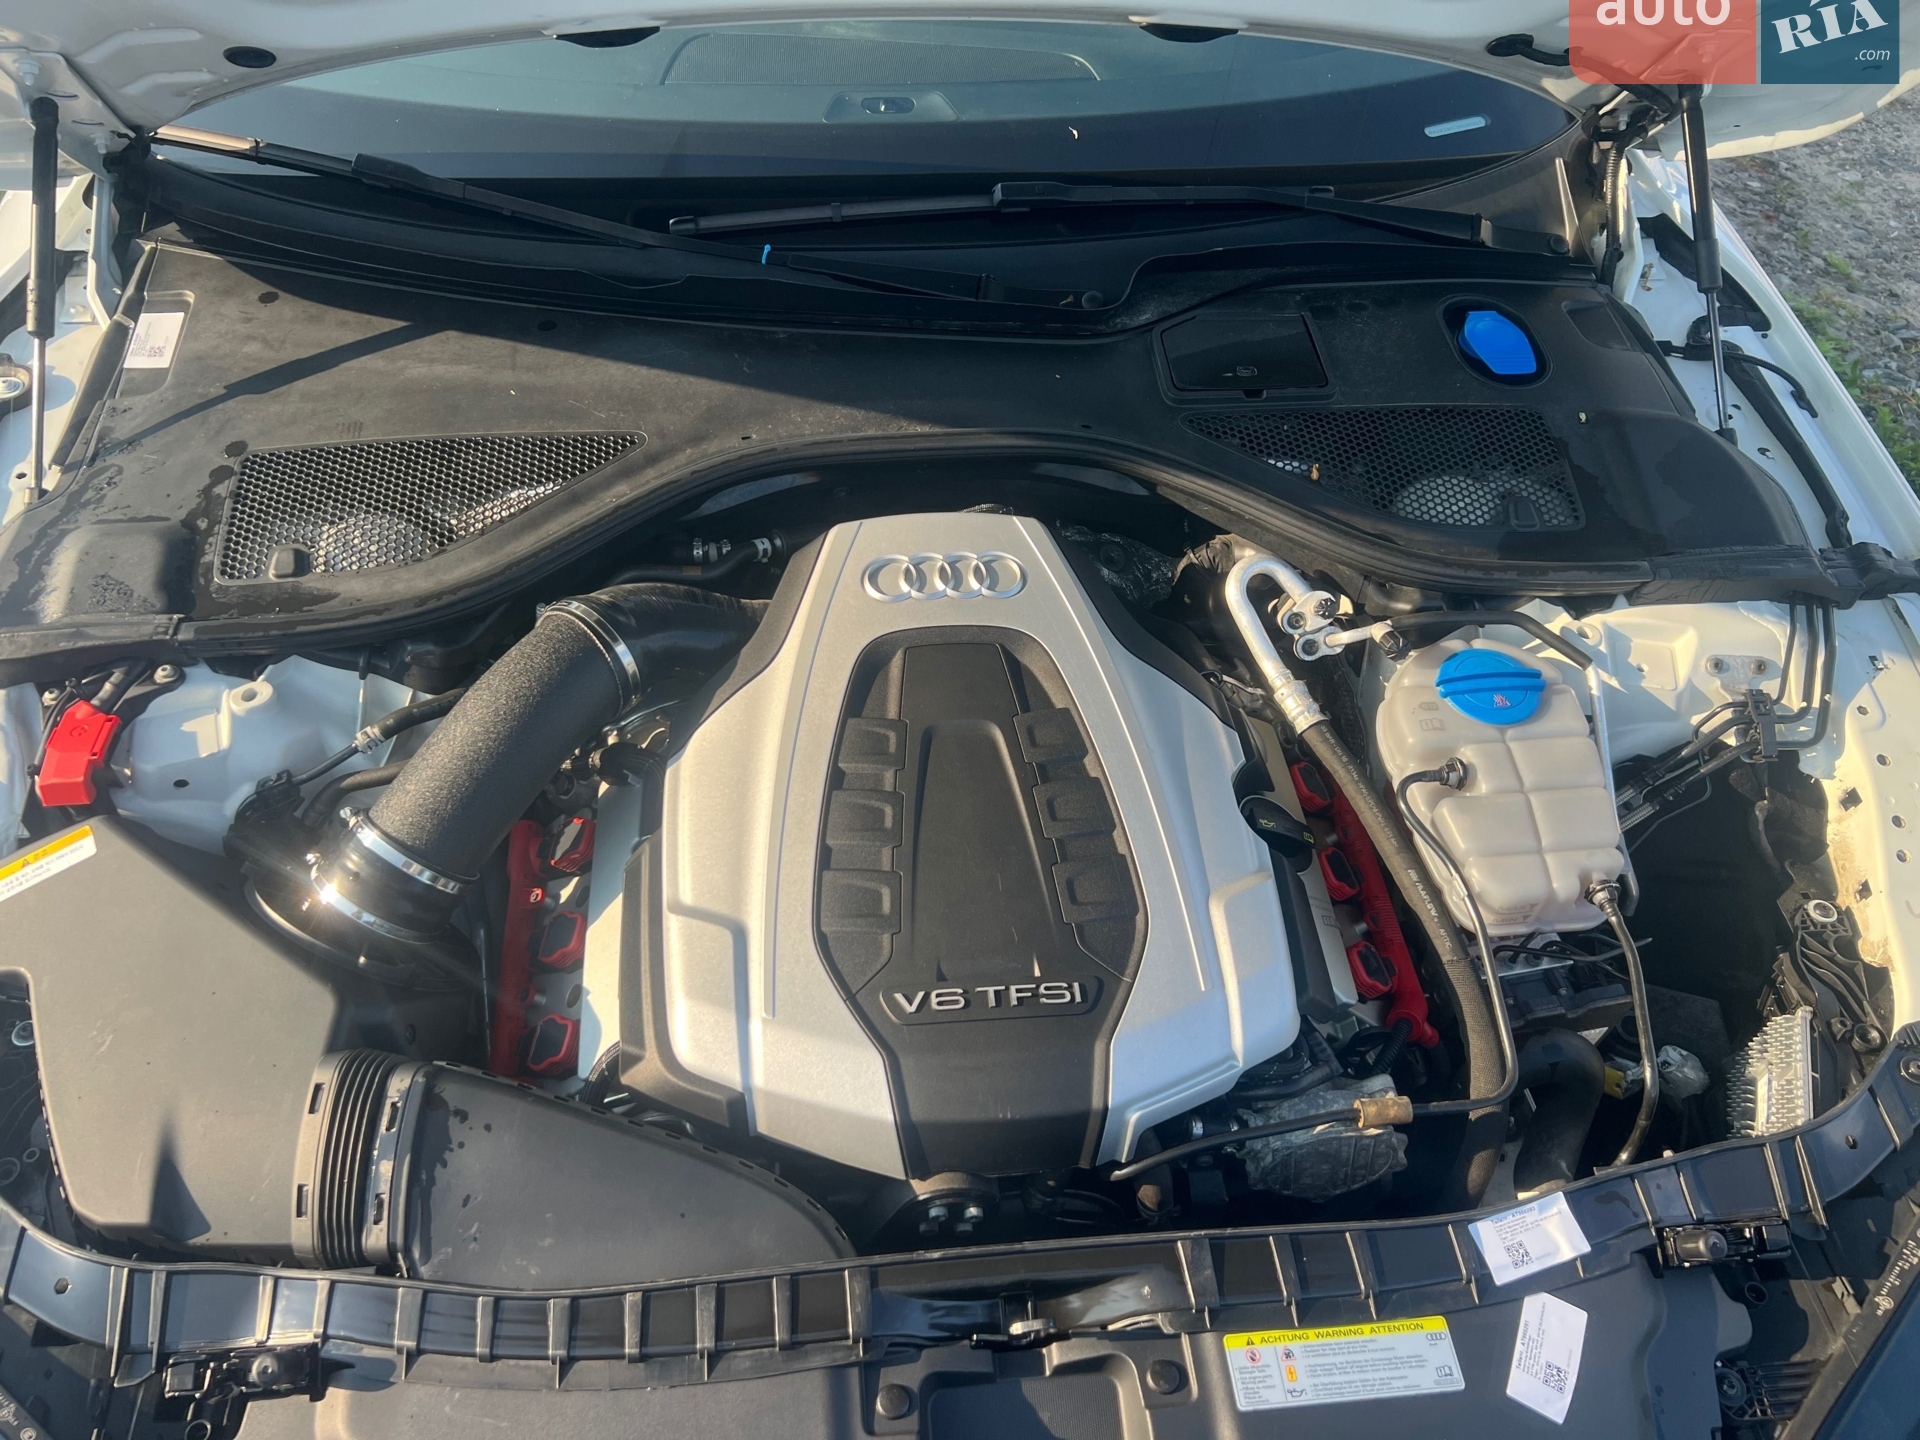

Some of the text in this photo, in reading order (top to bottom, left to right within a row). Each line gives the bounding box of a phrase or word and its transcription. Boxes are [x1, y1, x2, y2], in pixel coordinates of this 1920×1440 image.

[893, 982, 1082, 1014] V6 TFSI
[1259, 1321, 1425, 1345] ACHTUNG WARNING ATTENTION
